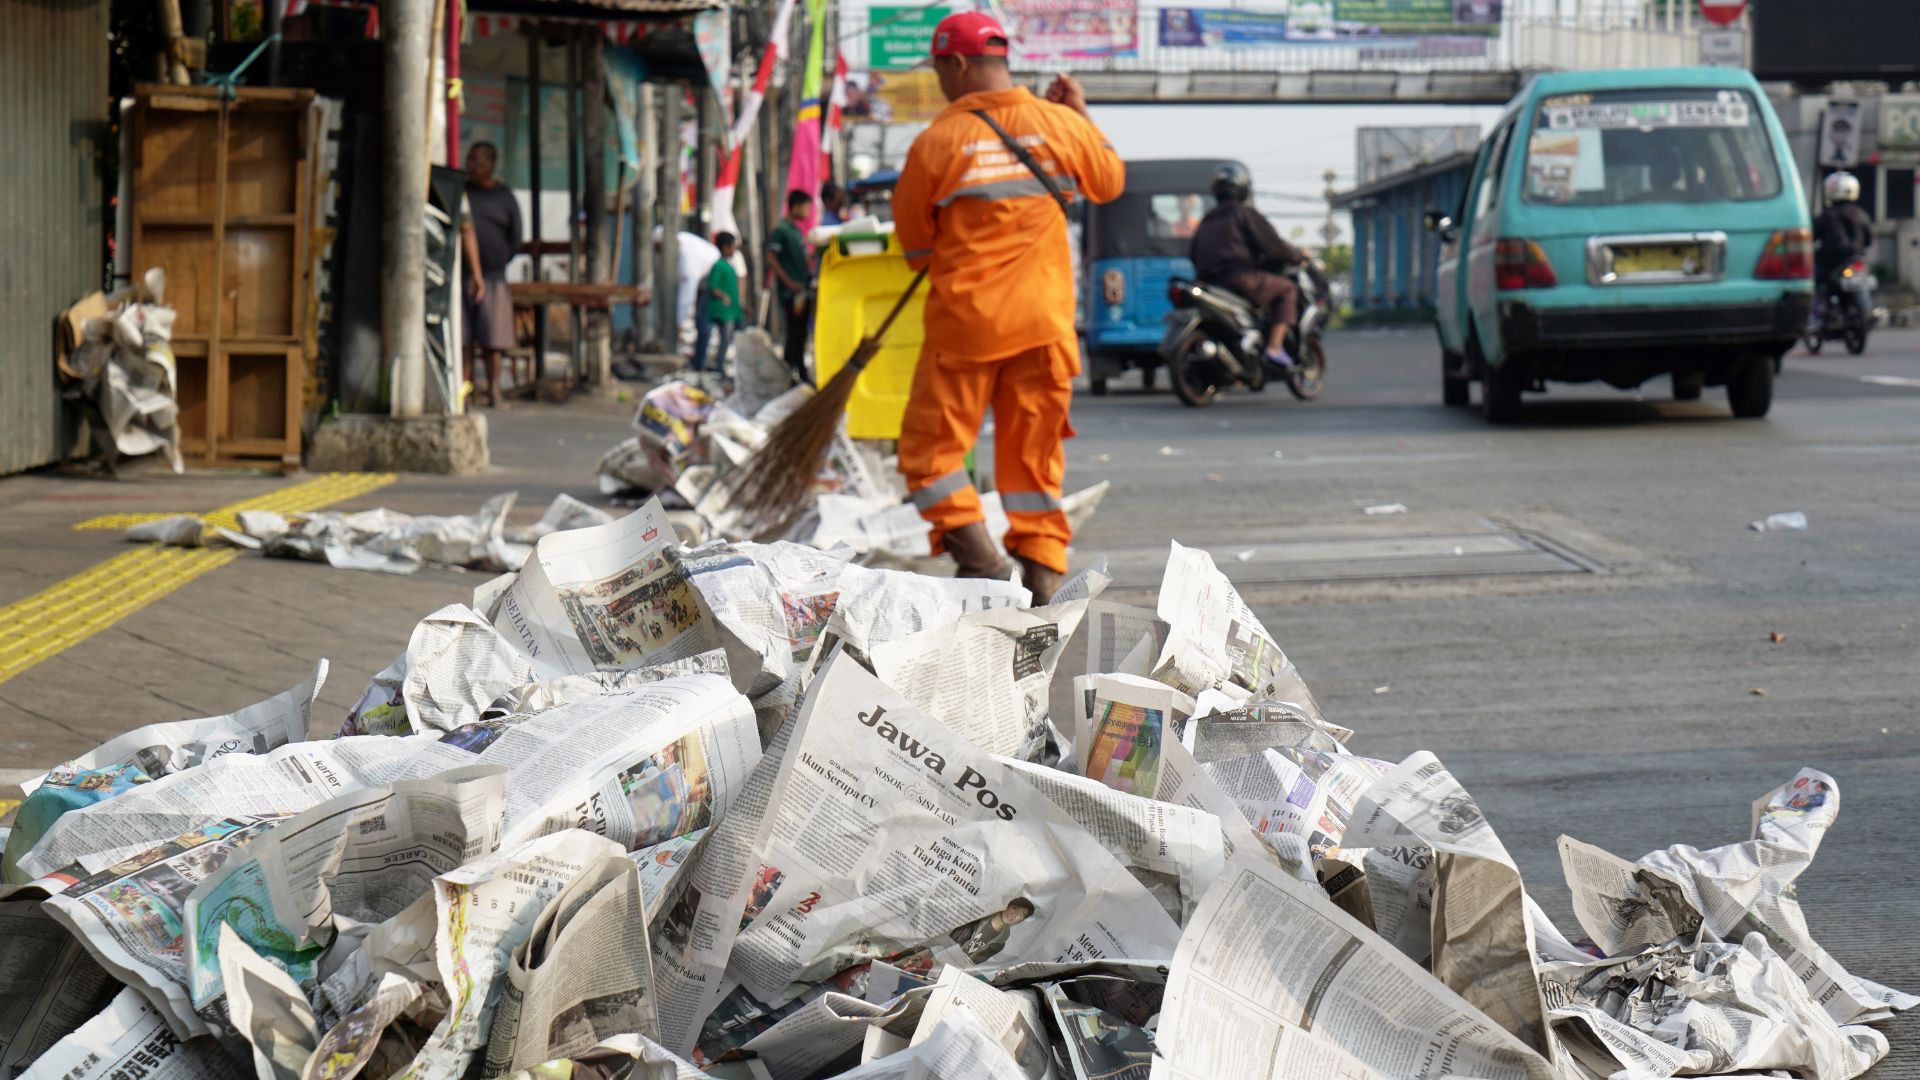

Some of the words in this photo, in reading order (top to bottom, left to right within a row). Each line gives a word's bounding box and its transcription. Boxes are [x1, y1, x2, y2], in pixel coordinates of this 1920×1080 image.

[313, 758, 341, 789] karier
[829, 760, 840, 770] GITA
[841, 768, 859, 782] ARIFIN
[858, 705, 946, 775] Jawa
[954, 765, 1017, 821] Pos
[799, 752, 825, 775] Akun
[824, 769, 860, 799] Serupa
[860, 794, 880, 809] CV
[873, 766, 905, 792] SOSOK
[934, 807, 958, 827] LAIN
[942, 836, 960, 850] KENNY
[960, 848, 979, 862] AUSTIN
[1157, 828, 1166, 856] Bacaleg
[384, 850, 428, 864] CAREER
[912, 845, 934, 867] Tiap
[935, 861, 947, 874] ke
[947, 869, 980, 896] Pantai
[929, 841, 951, 861] Jaga
[952, 857, 977, 877] Kulit
[89, 894, 117, 919] IMAX
[765, 921, 801, 949] Indonesia
[773, 914, 807, 940] Untukmu
[1076, 933, 1099, 959] Metal
[663, 951, 680, 972] Anjing
[680, 966, 706, 983] Pelacak
[1430, 1014, 1475, 1046] Fintech
[1645, 1046, 1679, 1071] Rayakan
